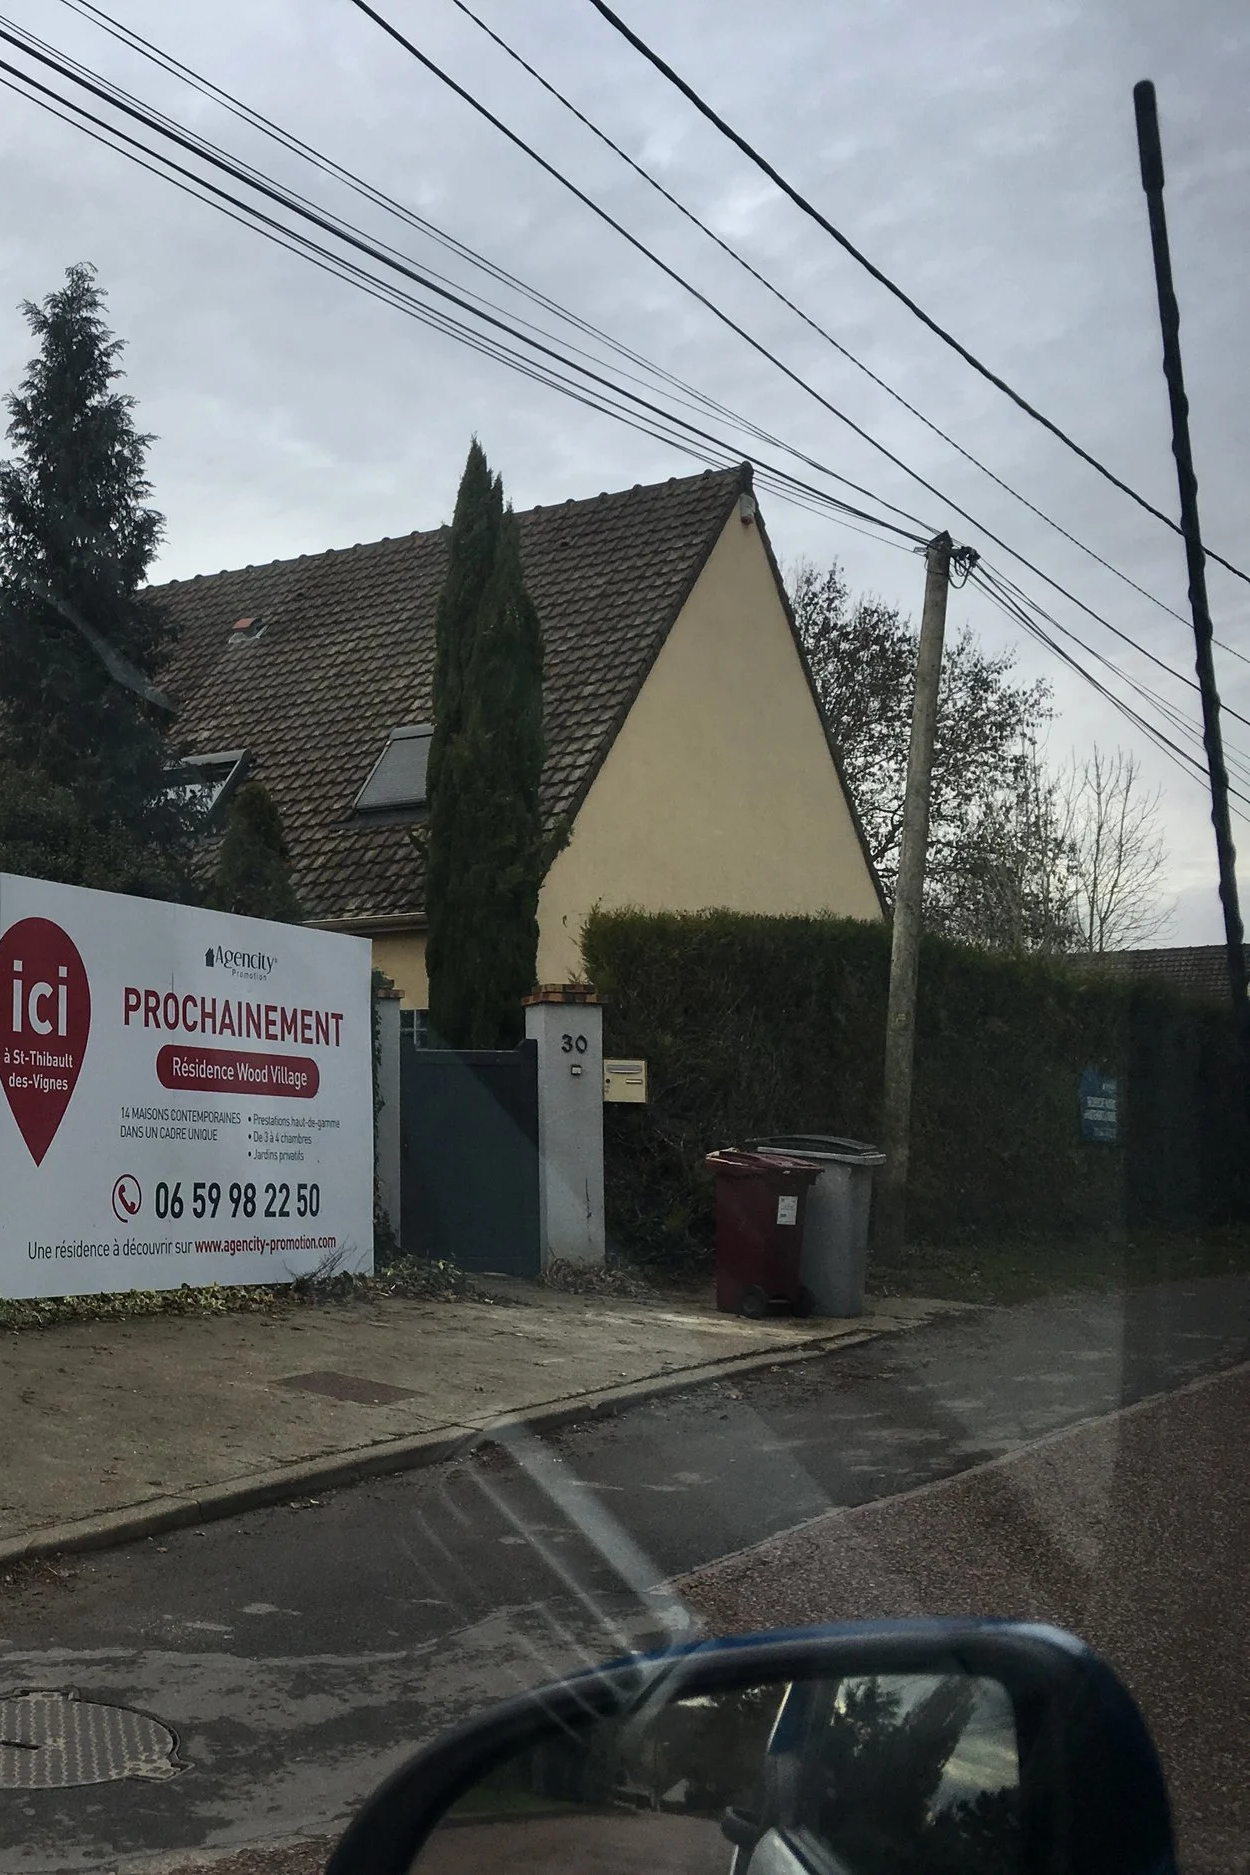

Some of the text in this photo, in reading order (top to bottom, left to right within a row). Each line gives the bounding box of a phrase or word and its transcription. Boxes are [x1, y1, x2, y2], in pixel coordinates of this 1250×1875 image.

[231, 968, 267, 981] Promotion
[12, 959, 68, 1037] ici
[123, 987, 344, 1047] PROCHAINEMENT
[561, 1033, 588, 1054] 30
[3, 1047, 73, 1068] à St-Thibault
[8, 1072, 69, 1093] des-Vignes
[172, 1056, 308, 1090] Résidence Wood Village
[121, 1106, 242, 1124] 14 MAISONS CONTEMPORAINES
[253, 1113, 340, 1131] Prestations haut-de-gamme
[120, 1125, 218, 1141] DANS UN CADRE UNIQUE
[253, 1131, 263, 1143] De
[264, 1131, 269, 1143] 3
[281, 1133, 312, 1145] chambres
[253, 1149, 304, 1163] Jardins privatifs
[155, 1181, 321, 1220] 06 59 98 22 50
[28, 1234, 337, 1260] Une résidence à découvrir sur www.agencity-promotion.com
